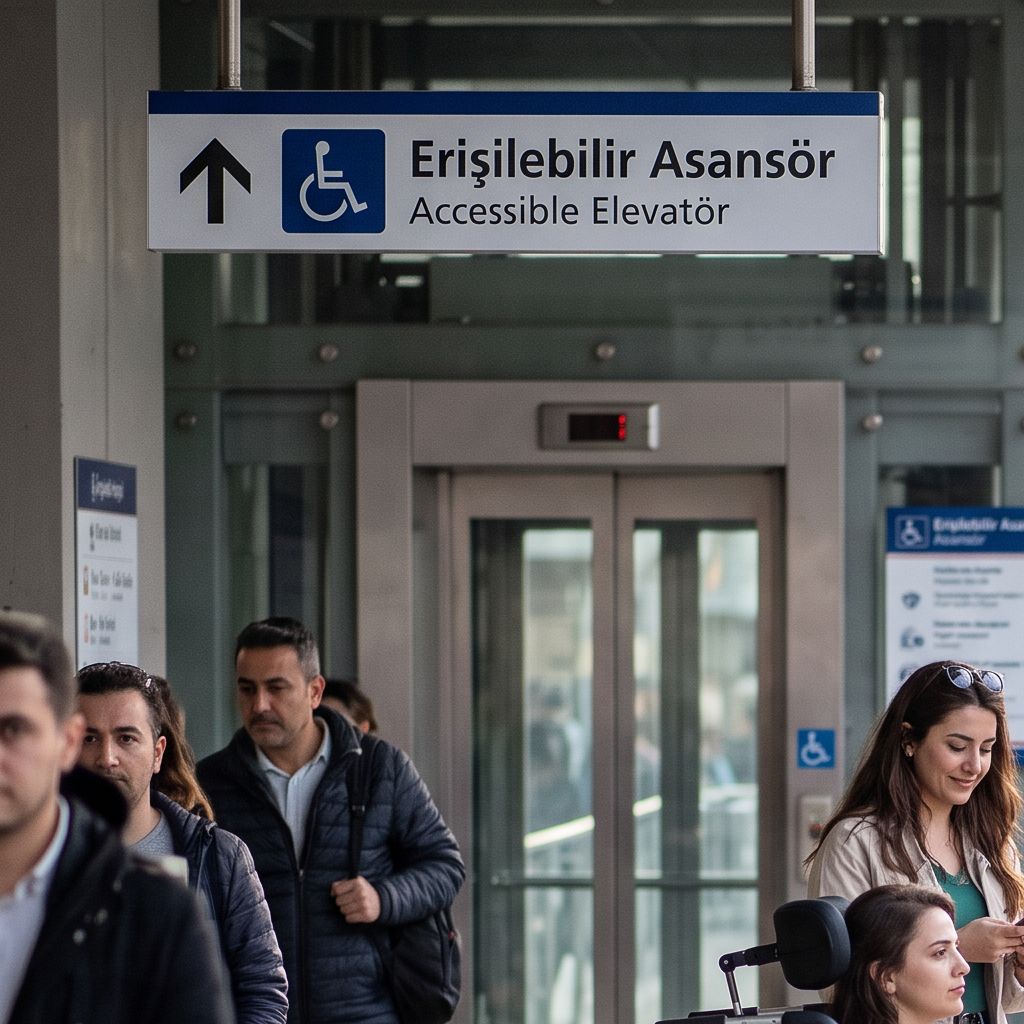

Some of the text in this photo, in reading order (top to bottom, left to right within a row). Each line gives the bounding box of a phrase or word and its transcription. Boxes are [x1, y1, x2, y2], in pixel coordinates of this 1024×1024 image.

[411, 137, 836, 189] Erişilebilir Asansör
[408, 195, 730, 225] Accessible Elevatör
